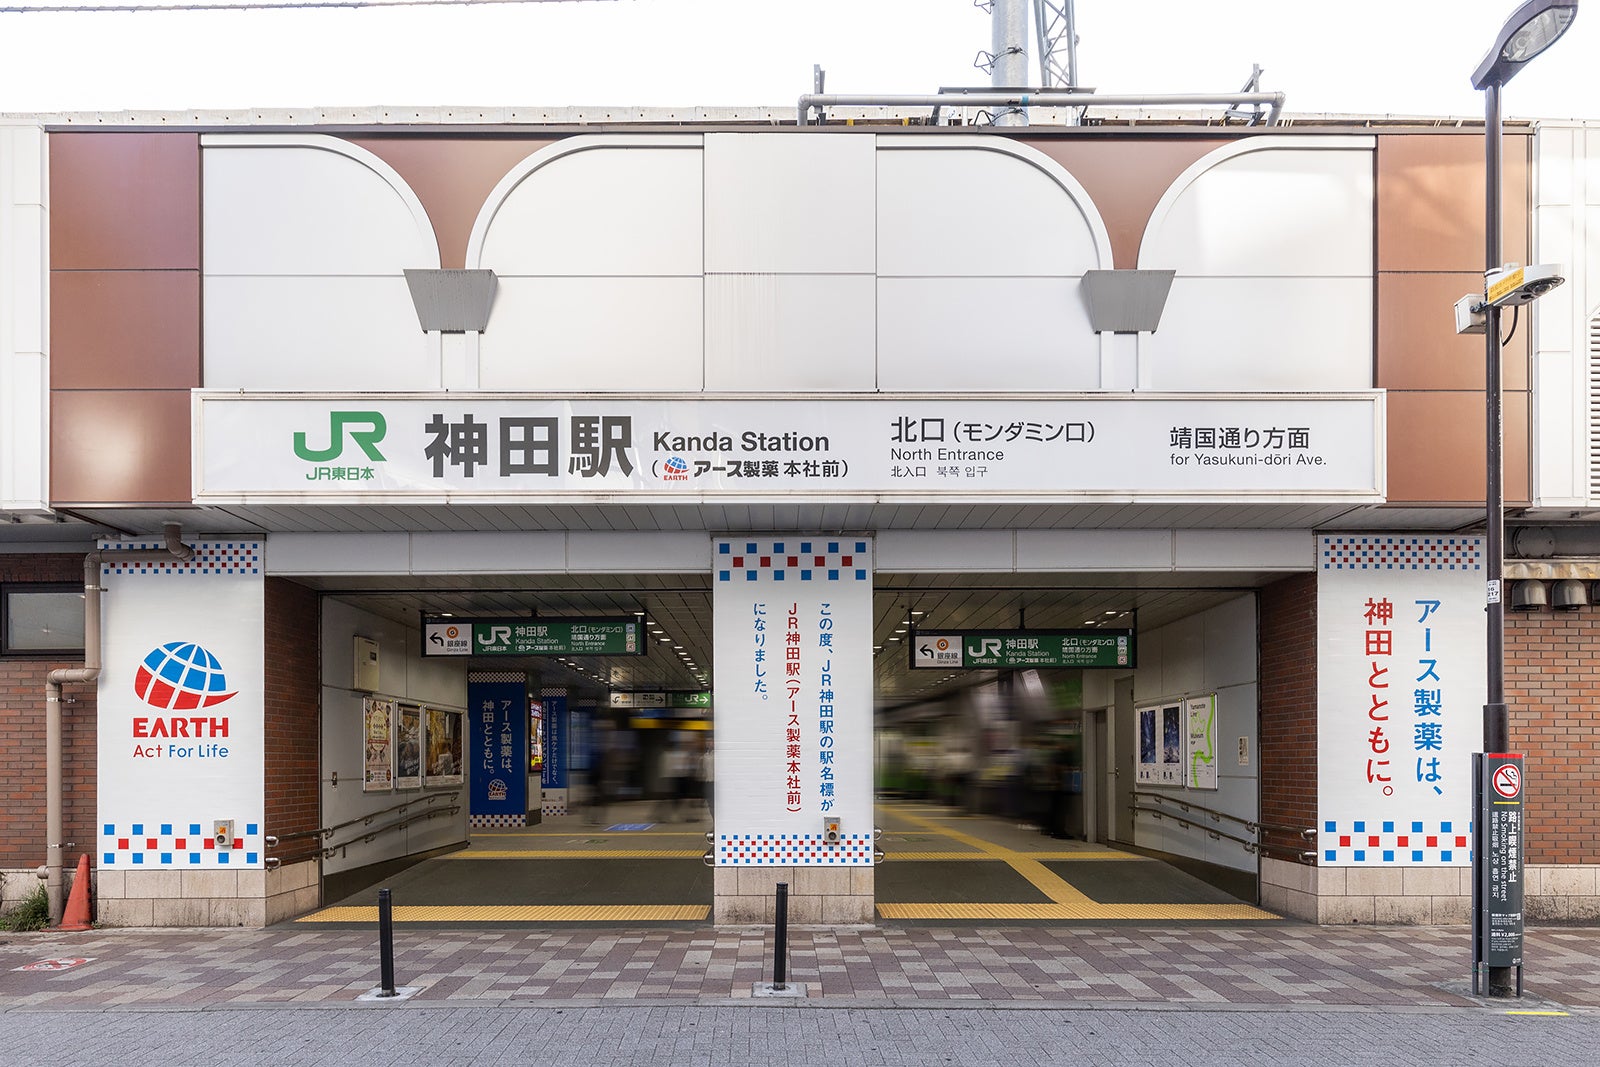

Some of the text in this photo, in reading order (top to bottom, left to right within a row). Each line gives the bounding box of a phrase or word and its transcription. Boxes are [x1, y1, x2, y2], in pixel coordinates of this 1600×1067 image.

[294, 411, 387, 462] JR
[891, 416, 944, 442] 北口
[1170, 427, 1310, 449] 靖国通り方面
[424, 414, 634, 477] 神田駅
[653, 431, 829, 451] Kanda Station
[891, 448, 1004, 460] North Entrance
[1170, 453, 1327, 465] for Yasukuni-dōri Ave.
[306, 467, 374, 480] JR東日本
[694, 460, 779, 477] アース製薬
[891, 466, 926, 477] 北入口
[478, 626, 512, 645] JR
[515, 626, 548, 637] 神田駅
[571, 625, 587, 633] 北口
[968, 638, 1002, 657] JR
[1006, 638, 1039, 649] 神田駅
[1062, 637, 1078, 646] 北口
[754, 603, 768, 700] になりました。
[1363, 597, 1393, 796] 神田とともに。
[1414, 599, 1443, 795] アース製薬は、
[819, 603, 835, 811] この度、JR神田駅の駅名標が
[133, 717, 229, 738] EARTH
[482, 700, 495, 774] 神田とともに。
[500, 700, 512, 774] アース製薬は、
[133, 744, 229, 758] Act For Life
[1501, 811, 1507, 821] No
[1501, 855, 1506, 865] on
